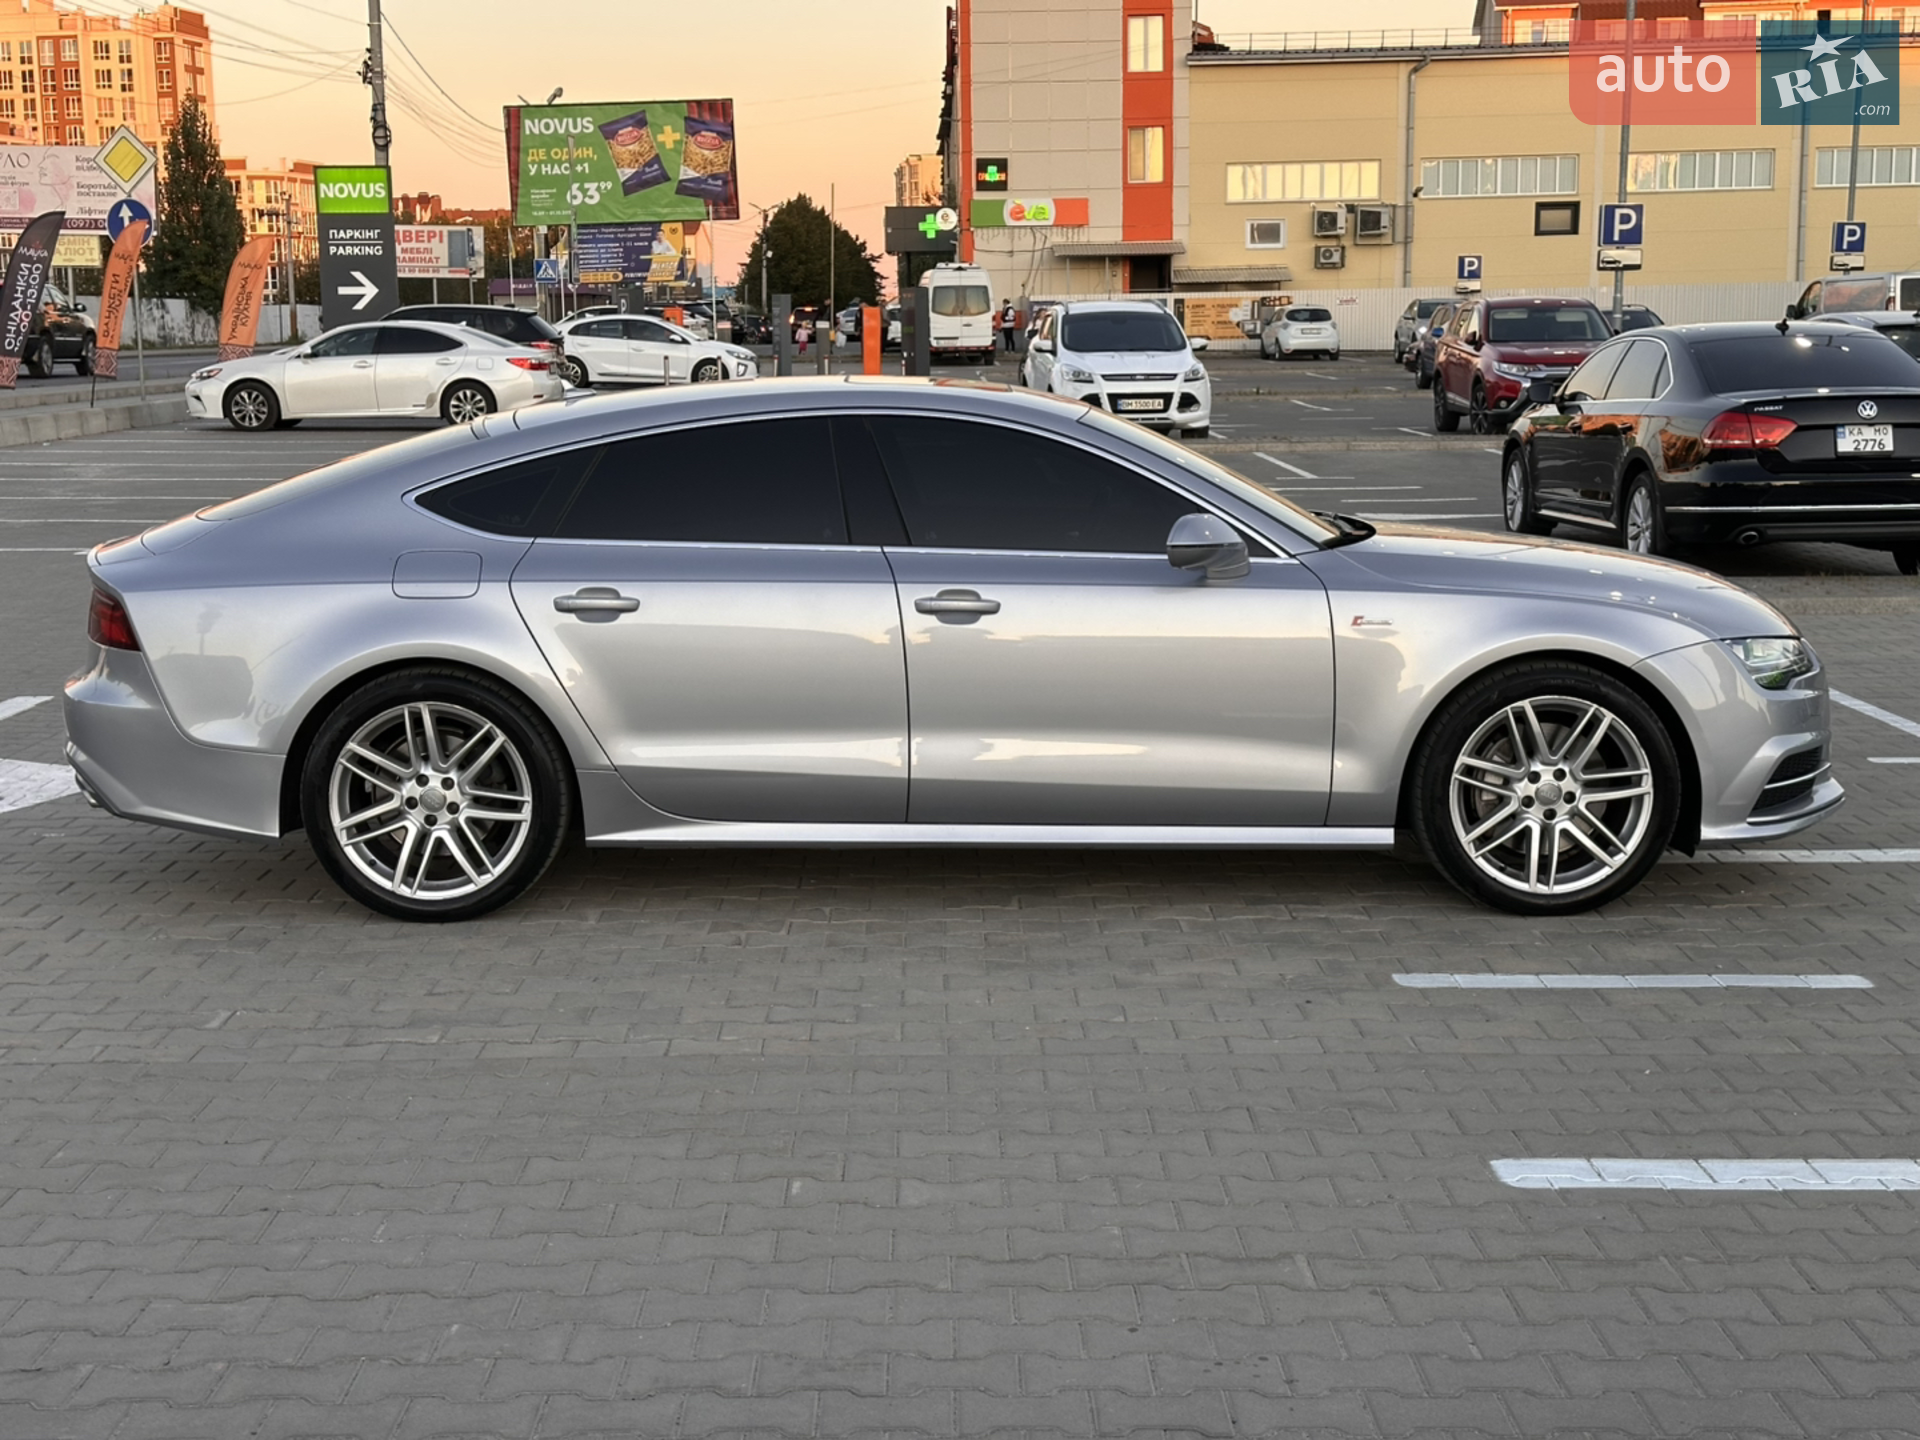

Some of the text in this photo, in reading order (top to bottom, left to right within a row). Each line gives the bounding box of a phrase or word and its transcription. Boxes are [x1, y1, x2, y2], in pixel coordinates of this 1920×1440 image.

[524, 116, 595, 135] NOVUS
[527, 146, 598, 162] ДЕ ОДИН,
[527, 162, 590, 176] У НАС +1
[319, 182, 387, 199] NOVUS
[566, 181, 601, 206] 63
[599, 181, 613, 190] 99
[57, 236, 91, 246] БМІН
[328, 229, 382, 240] ПАРКІНГ
[55, 247, 95, 256] АЛЮТ
[329, 246, 384, 256] PARKING
[400, 246, 433, 256] МЕБЛІ
[4, 263, 32, 350] СНІДАНКИ
[1848, 427, 1864, 436] KA
[1852, 438, 1886, 451] 2776
